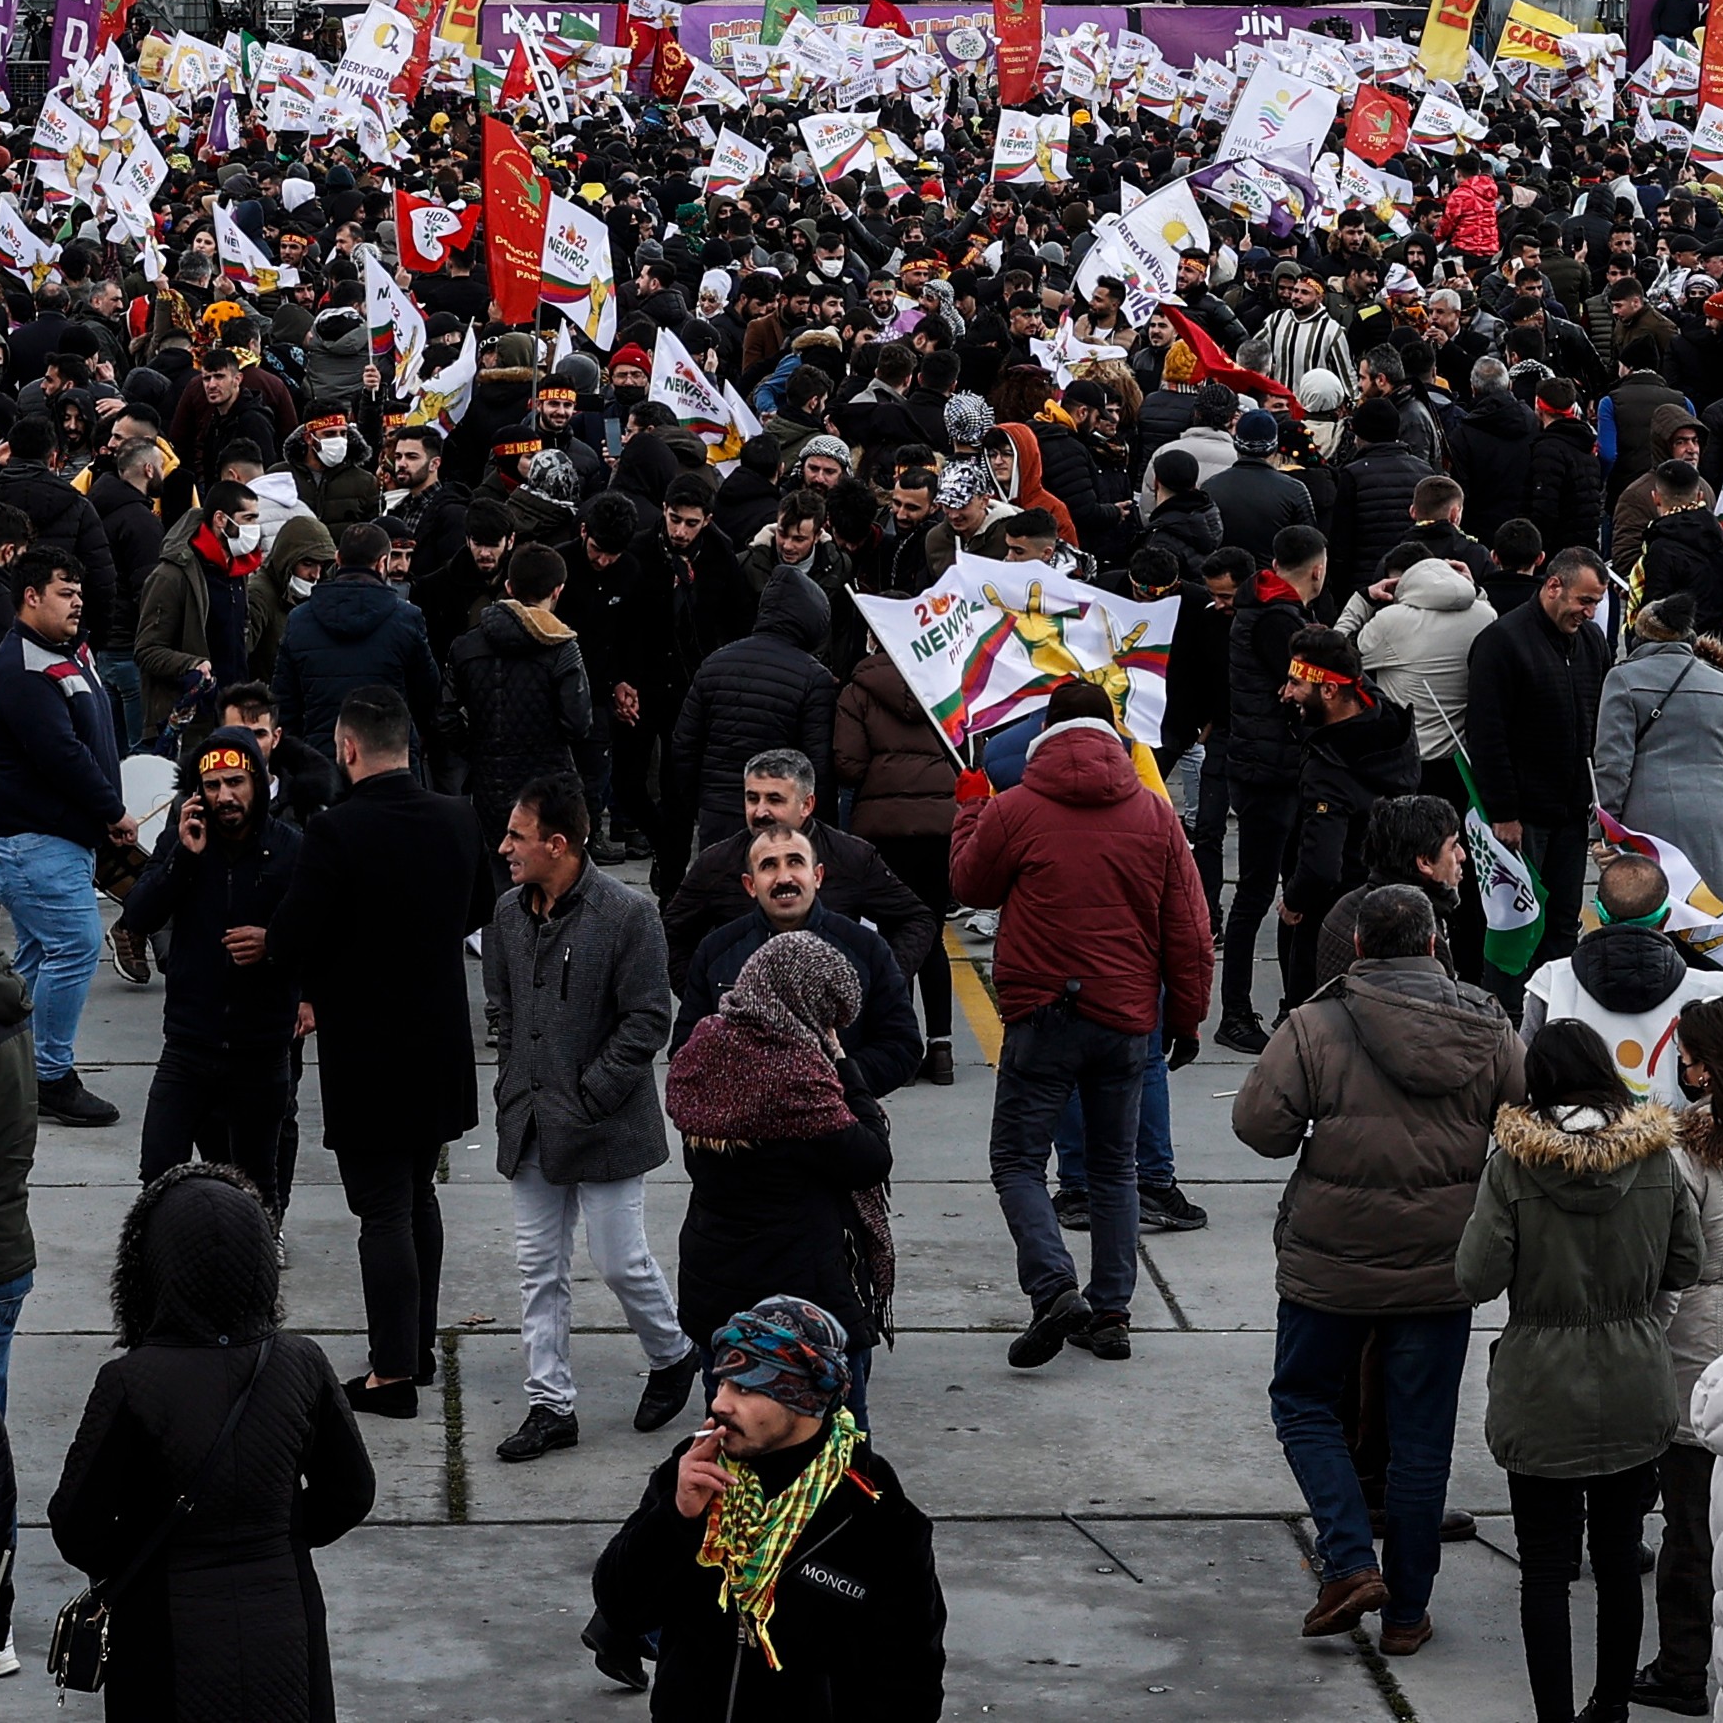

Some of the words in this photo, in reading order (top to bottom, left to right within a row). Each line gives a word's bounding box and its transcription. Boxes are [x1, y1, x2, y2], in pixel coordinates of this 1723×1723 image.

[1234, 9, 1283, 36] JİN
[663, 376, 717, 415] NEWROZ
[800, 1563, 867, 1600] MONCLER
